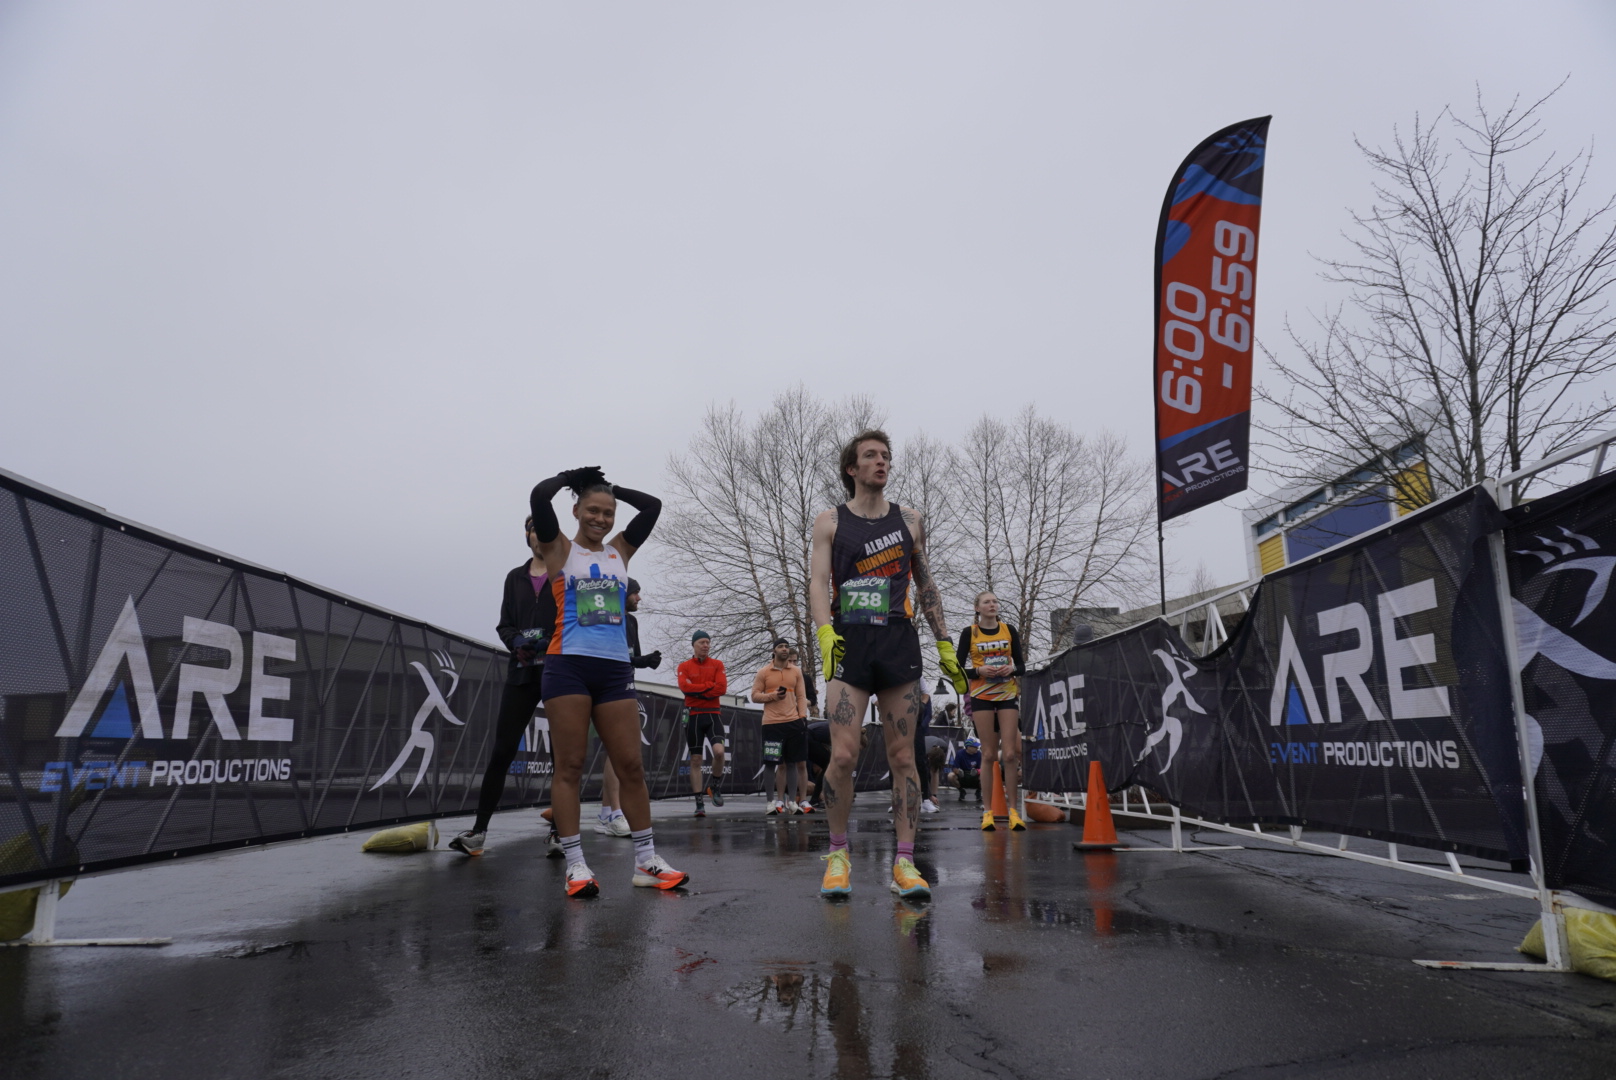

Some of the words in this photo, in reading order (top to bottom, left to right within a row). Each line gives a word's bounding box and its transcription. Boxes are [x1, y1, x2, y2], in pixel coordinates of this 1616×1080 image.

[1209, 219, 1256, 354] 6:59
[1161, 281, 1207, 414] 6:00
[1184, 465, 1245, 494] PRODUCTIONS
[855, 543, 905, 575] RUNNING
[864, 529, 904, 556] ALBANY
[593, 594, 606, 608] 8
[847, 591, 882, 607] 738
[54, 594, 297, 742] ARE
[1270, 578, 1451, 726] ARE
[1033, 673, 1087, 741] ARE
[1270, 742, 1319, 764] EVENT
[1323, 739, 1460, 769] PRODUCTIONS
[39, 761, 147, 793] EVENT
[150, 758, 292, 787] PRODUCTIONS
